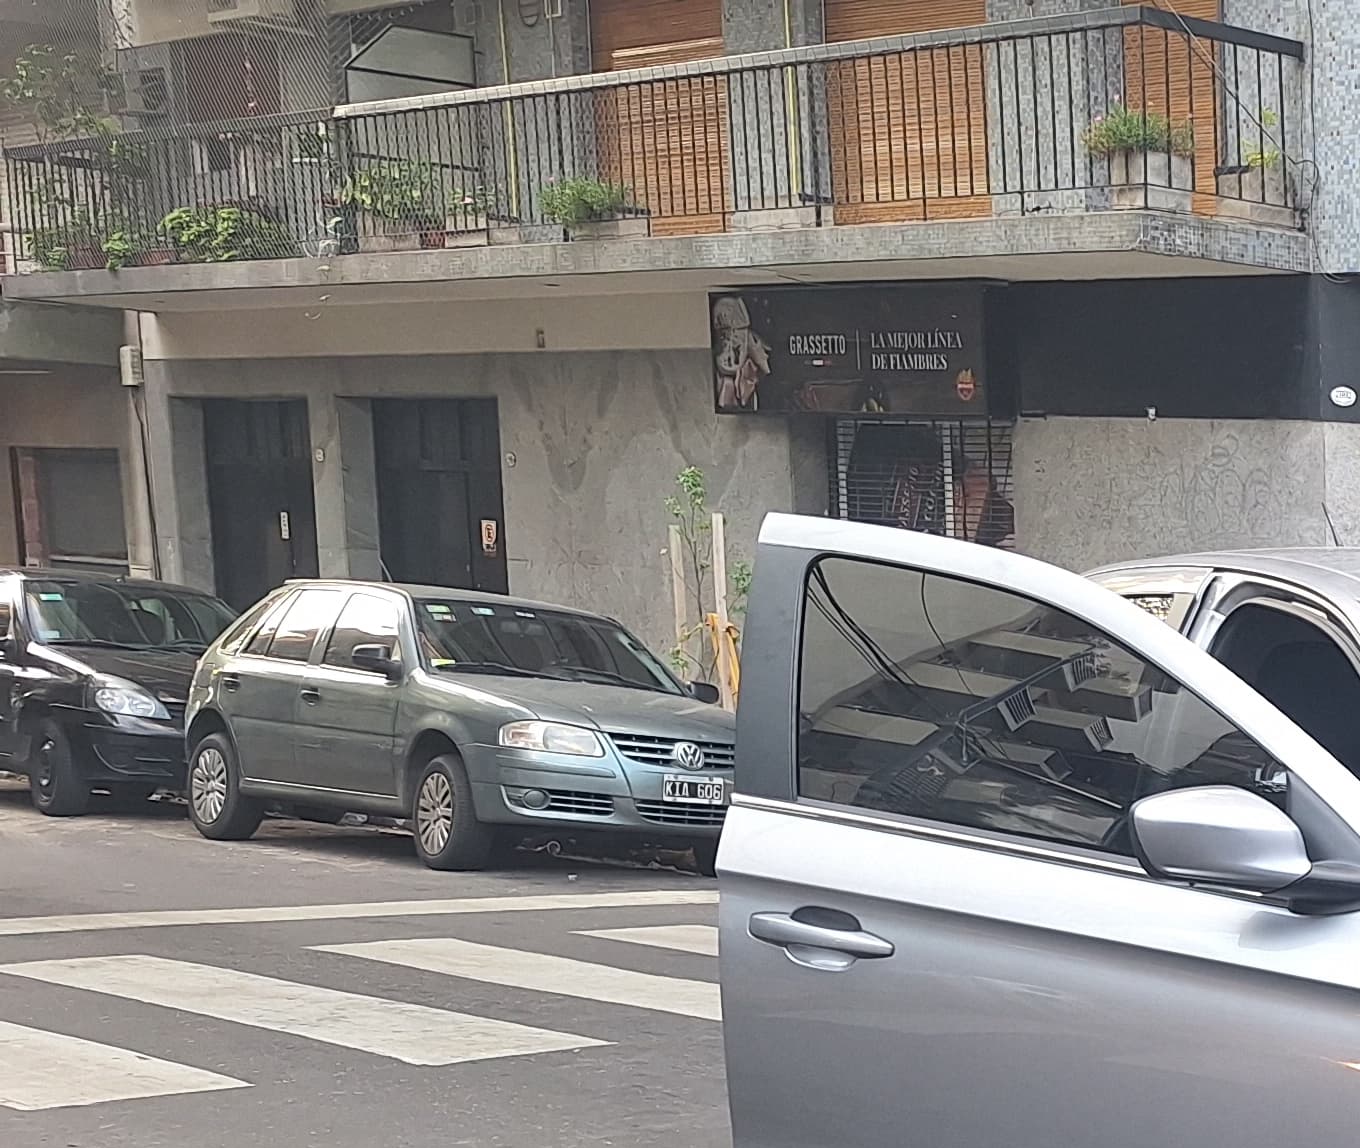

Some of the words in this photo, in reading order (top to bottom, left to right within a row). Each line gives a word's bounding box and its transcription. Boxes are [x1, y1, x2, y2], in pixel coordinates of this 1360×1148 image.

[789, 334, 846, 355] GRASSETTO
[871, 332, 885, 349] LA
[887, 332, 925, 351] MEJOR
[927, 328, 963, 349] LÍNEA
[872, 353, 888, 370] DE
[890, 353, 948, 370] FIAMBRES
[665, 781, 690, 797] KIA
[697, 783, 722, 800] 606
